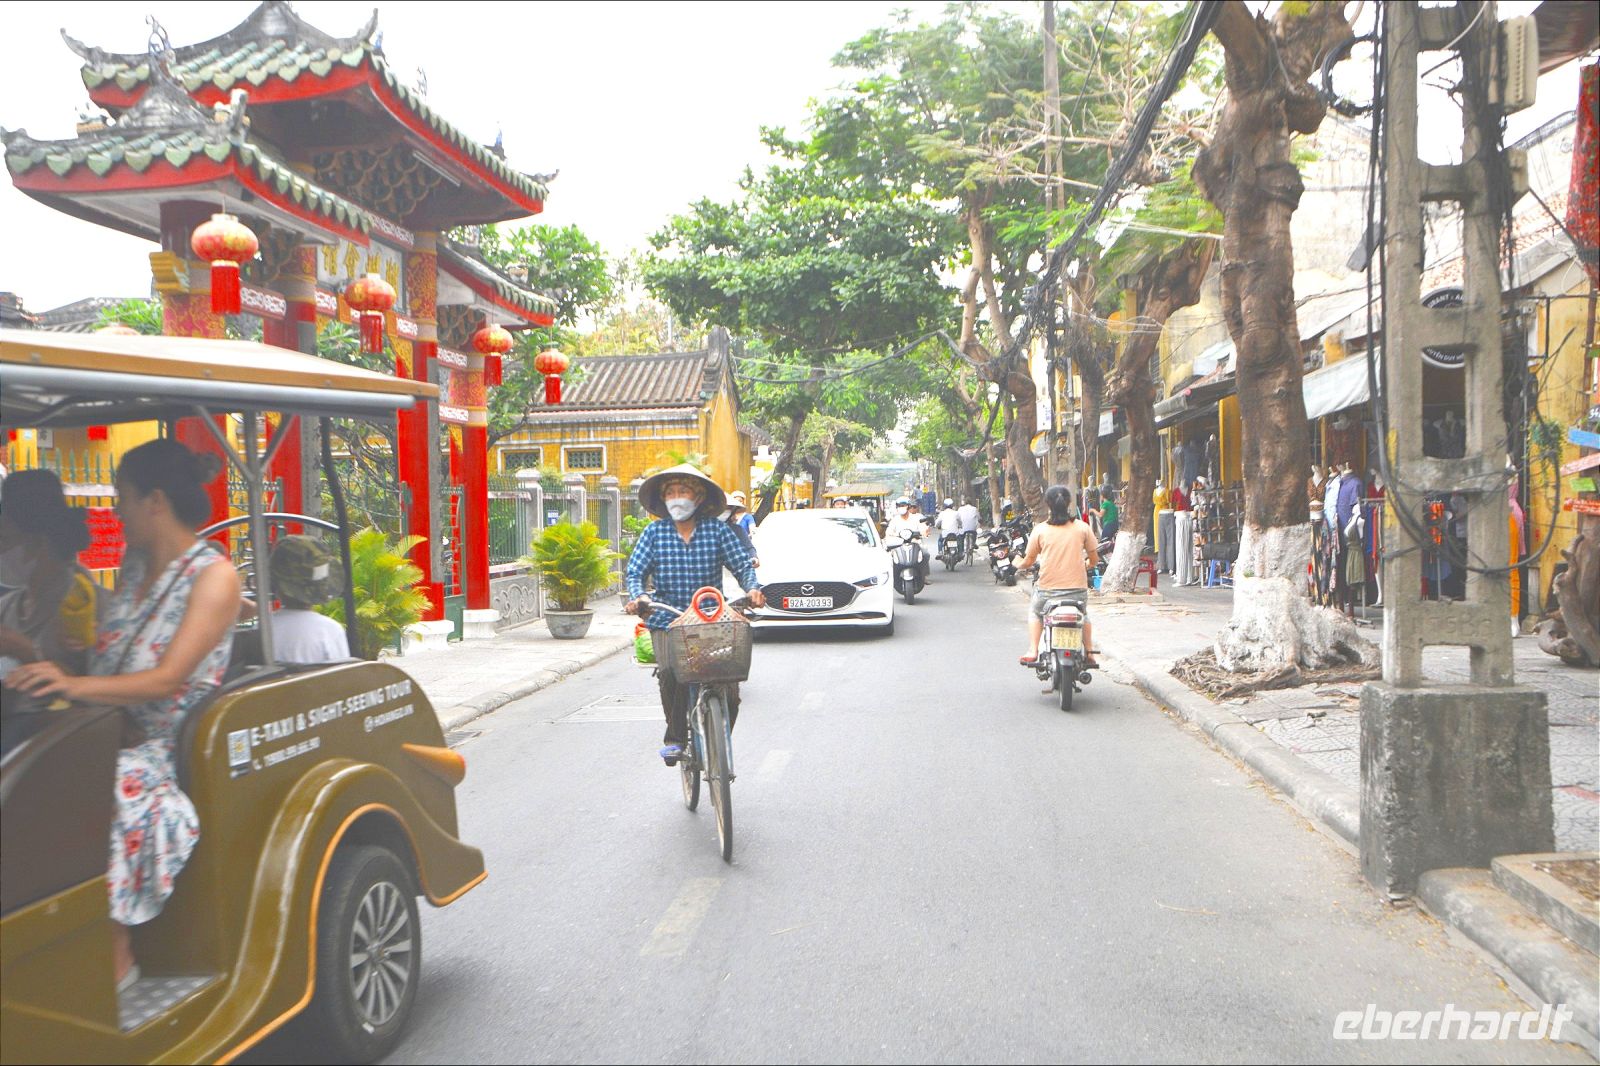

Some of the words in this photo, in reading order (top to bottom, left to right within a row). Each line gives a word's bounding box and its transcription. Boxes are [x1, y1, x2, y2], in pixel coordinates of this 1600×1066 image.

[250, 716, 294, 747] E-TAXI
[296, 712, 307, 731] &
[307, 687, 385, 728] SIGHT-SEEING
[384, 679, 412, 701] TOUR
